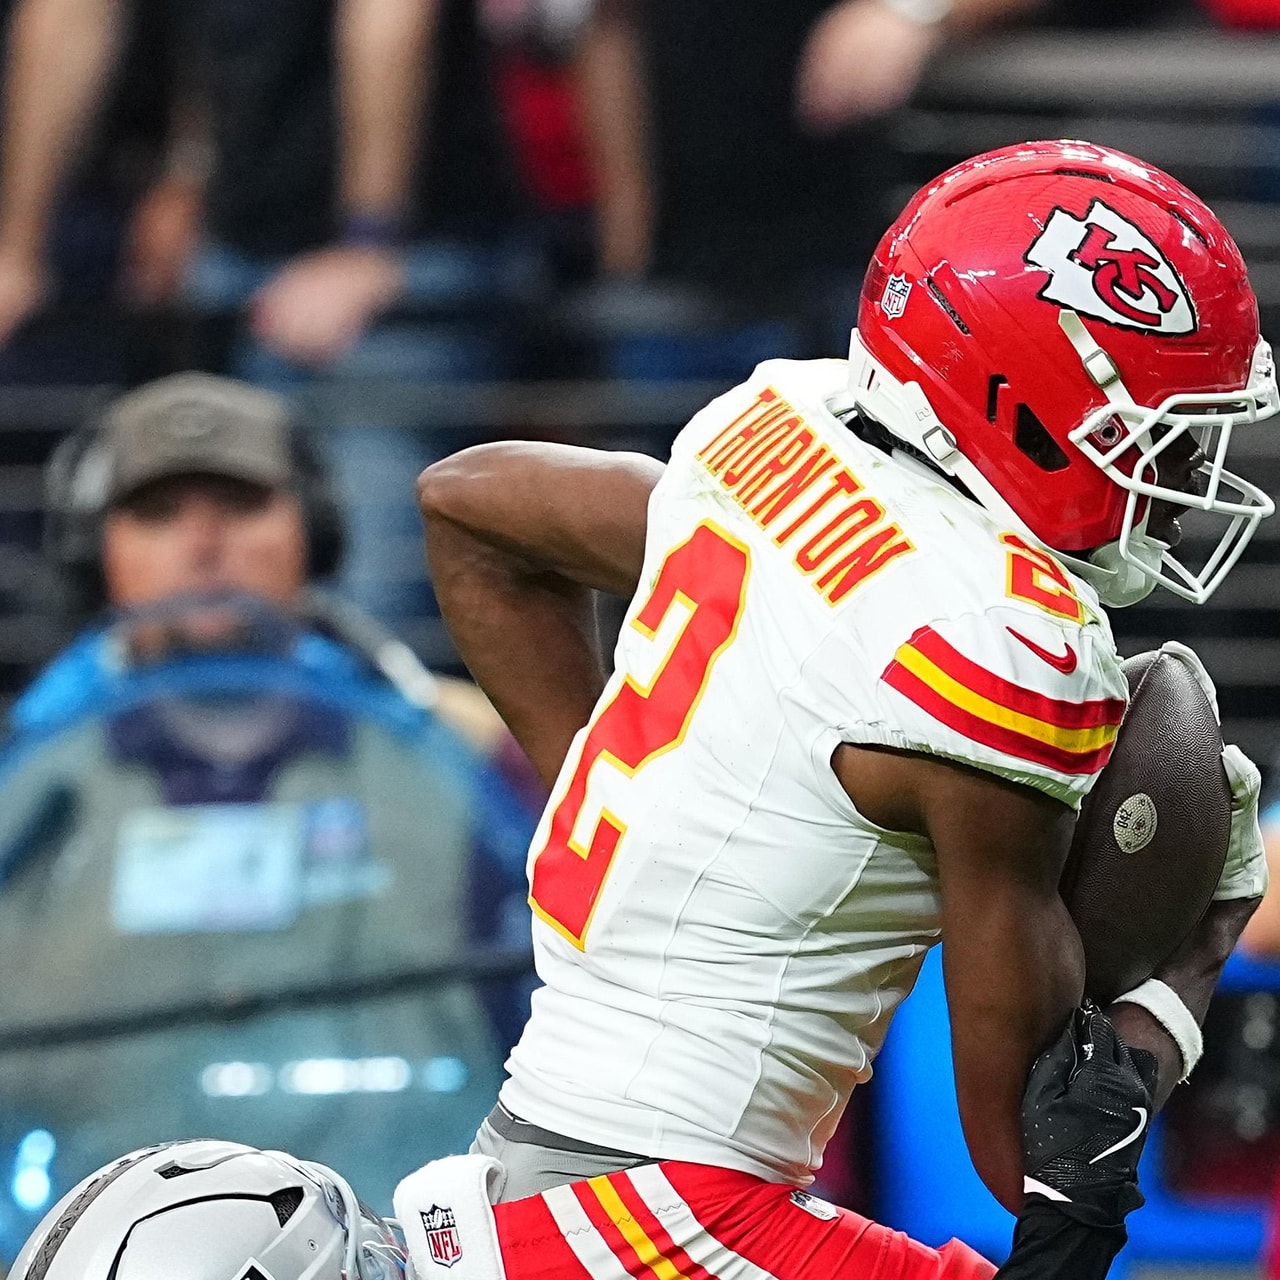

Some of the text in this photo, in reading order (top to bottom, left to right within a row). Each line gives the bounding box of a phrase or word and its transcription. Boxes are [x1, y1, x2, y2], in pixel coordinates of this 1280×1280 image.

[884, 290, 902, 313] NFL
[694, 384, 917, 608] THORNTON
[998, 531, 1086, 627] 2
[528, 518, 751, 952] 2
[429, 1229, 461, 1262] NFL
